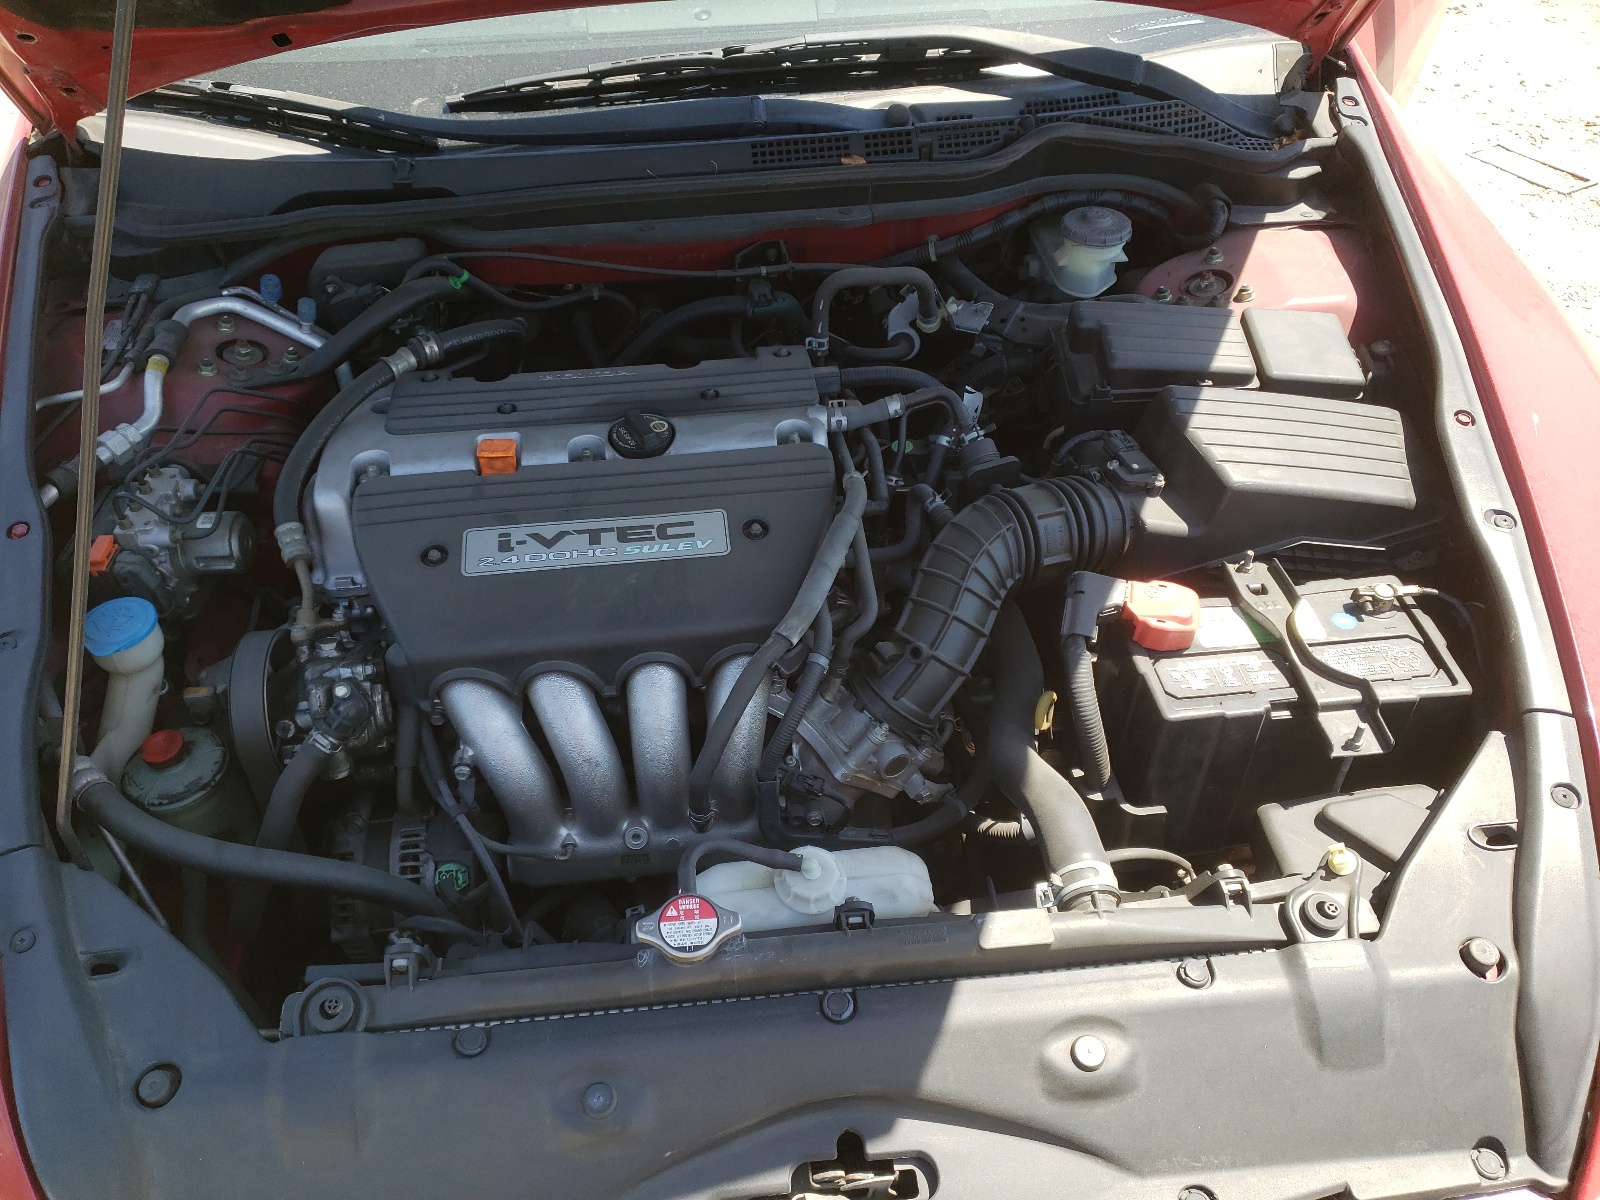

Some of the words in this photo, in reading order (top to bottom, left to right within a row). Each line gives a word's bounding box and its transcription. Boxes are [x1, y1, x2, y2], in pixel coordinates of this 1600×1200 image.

[497, 520, 696, 553] i-VTEC
[477, 554, 521, 568] 2.4
[524, 546, 618, 563] DOHC
[623, 538, 714, 555] SULEV
